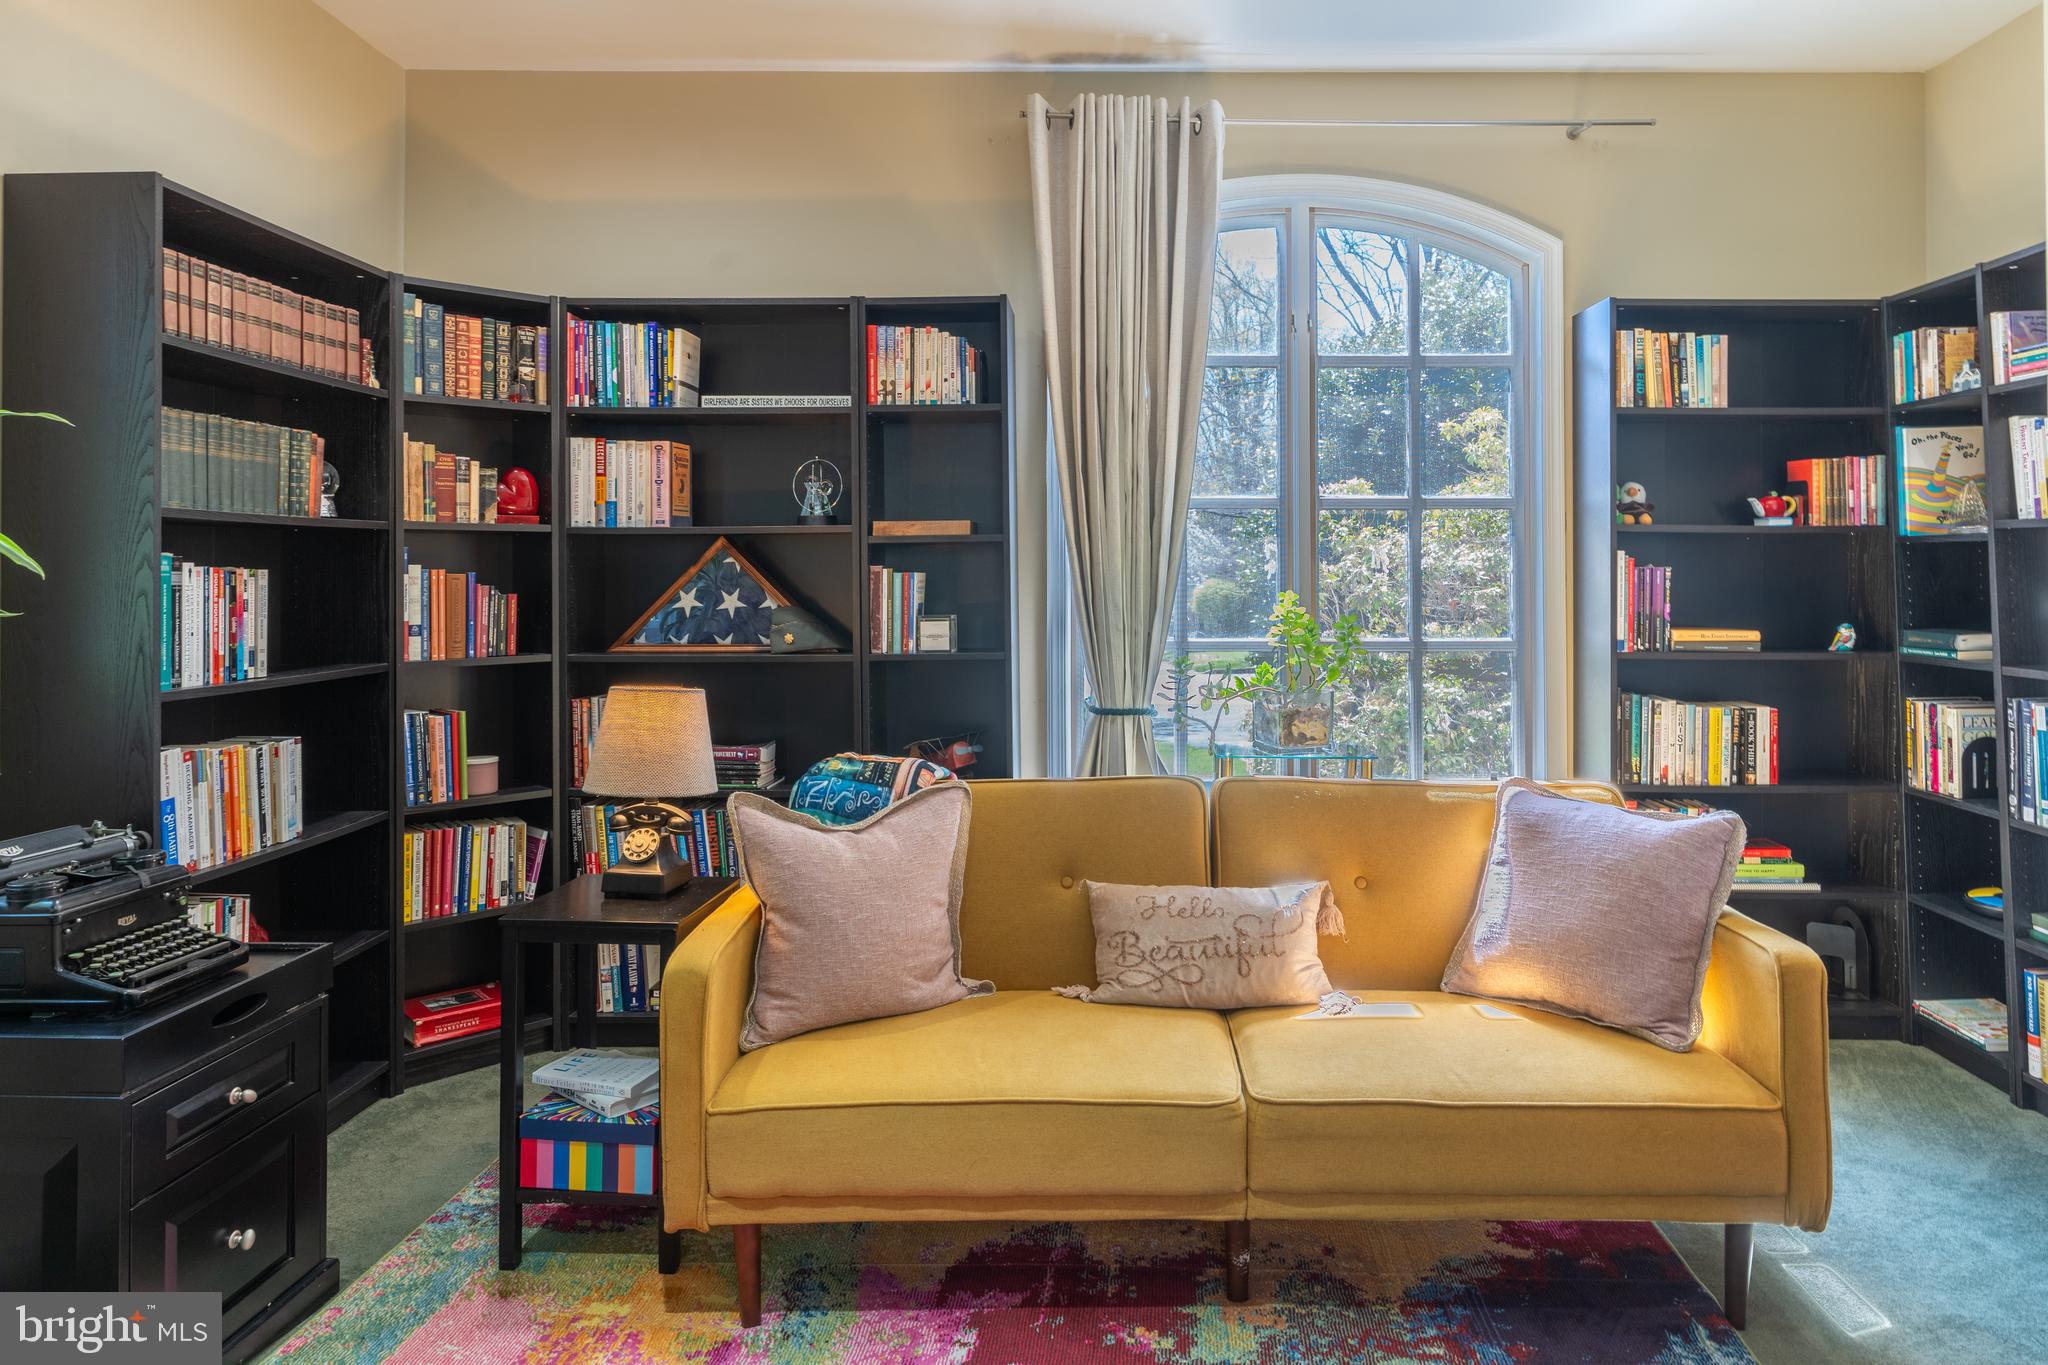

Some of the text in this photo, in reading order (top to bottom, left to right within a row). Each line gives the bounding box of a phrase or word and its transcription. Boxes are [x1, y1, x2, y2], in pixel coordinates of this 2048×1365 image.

[704, 397, 849, 406] GIRLFRIENDS ARE SISTERS WE CHOOSE FOR OURSELVES
[1912, 437, 1926, 446] Oh,
[1940, 432, 1962, 442] Places
[1955, 443, 1974, 451] You'll
[1962, 448, 1980, 459] Go!
[597, 442, 605, 474] EXECUTION
[655, 445, 664, 510] ORGANIZATION DEVELOPMENT
[1748, 739, 1756, 766] THIEF
[164, 814, 176, 830] 8th
[570, 810, 578, 836] STRATEGIC
[168, 831, 177, 860] HABIT
[608, 836, 614, 844] HR
[707, 814, 720, 868] TRACTION
[0, 845, 23, 856] OYAL
[728, 866, 736, 878] Cap
[1136, 895, 1226, 920] Hello
[118, 914, 137, 926] ROYAL
[1107, 913, 1303, 992] Beautiful
[629, 964, 638, 986] PLANNER
[434, 1020, 480, 1034] SHAKESPEARE
[552, 1052, 597, 1072] LIFE
[536, 1077, 576, 1088] Bruce Feiler
[560, 1086, 575, 1098] THEM
[580, 1086, 615, 1096] TRANSITIONS
